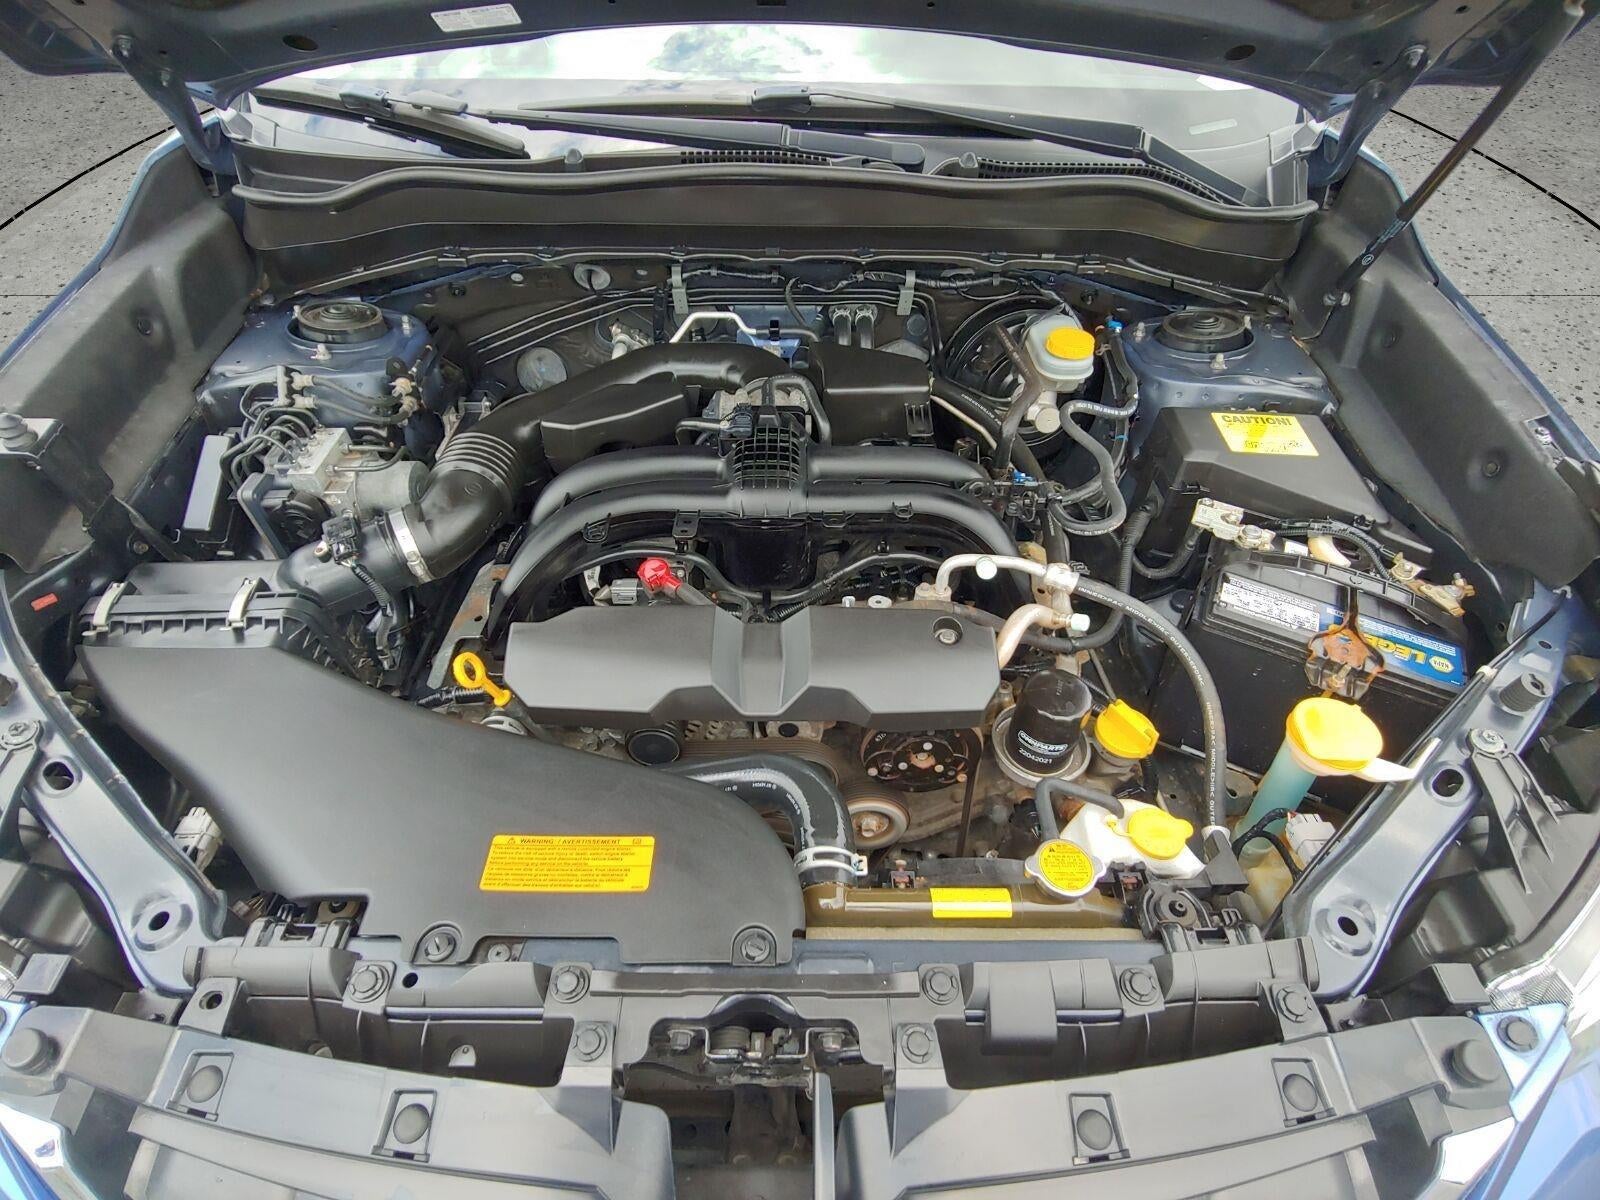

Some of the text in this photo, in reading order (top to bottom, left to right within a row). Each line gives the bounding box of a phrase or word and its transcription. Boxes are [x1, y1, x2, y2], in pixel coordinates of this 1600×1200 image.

[1221, 414, 1292, 426] CAUTION!
[1363, 633, 1427, 664] LEGE
[1433, 659, 1450, 670] NAPA
[1018, 747, 1053, 764] 22042021
